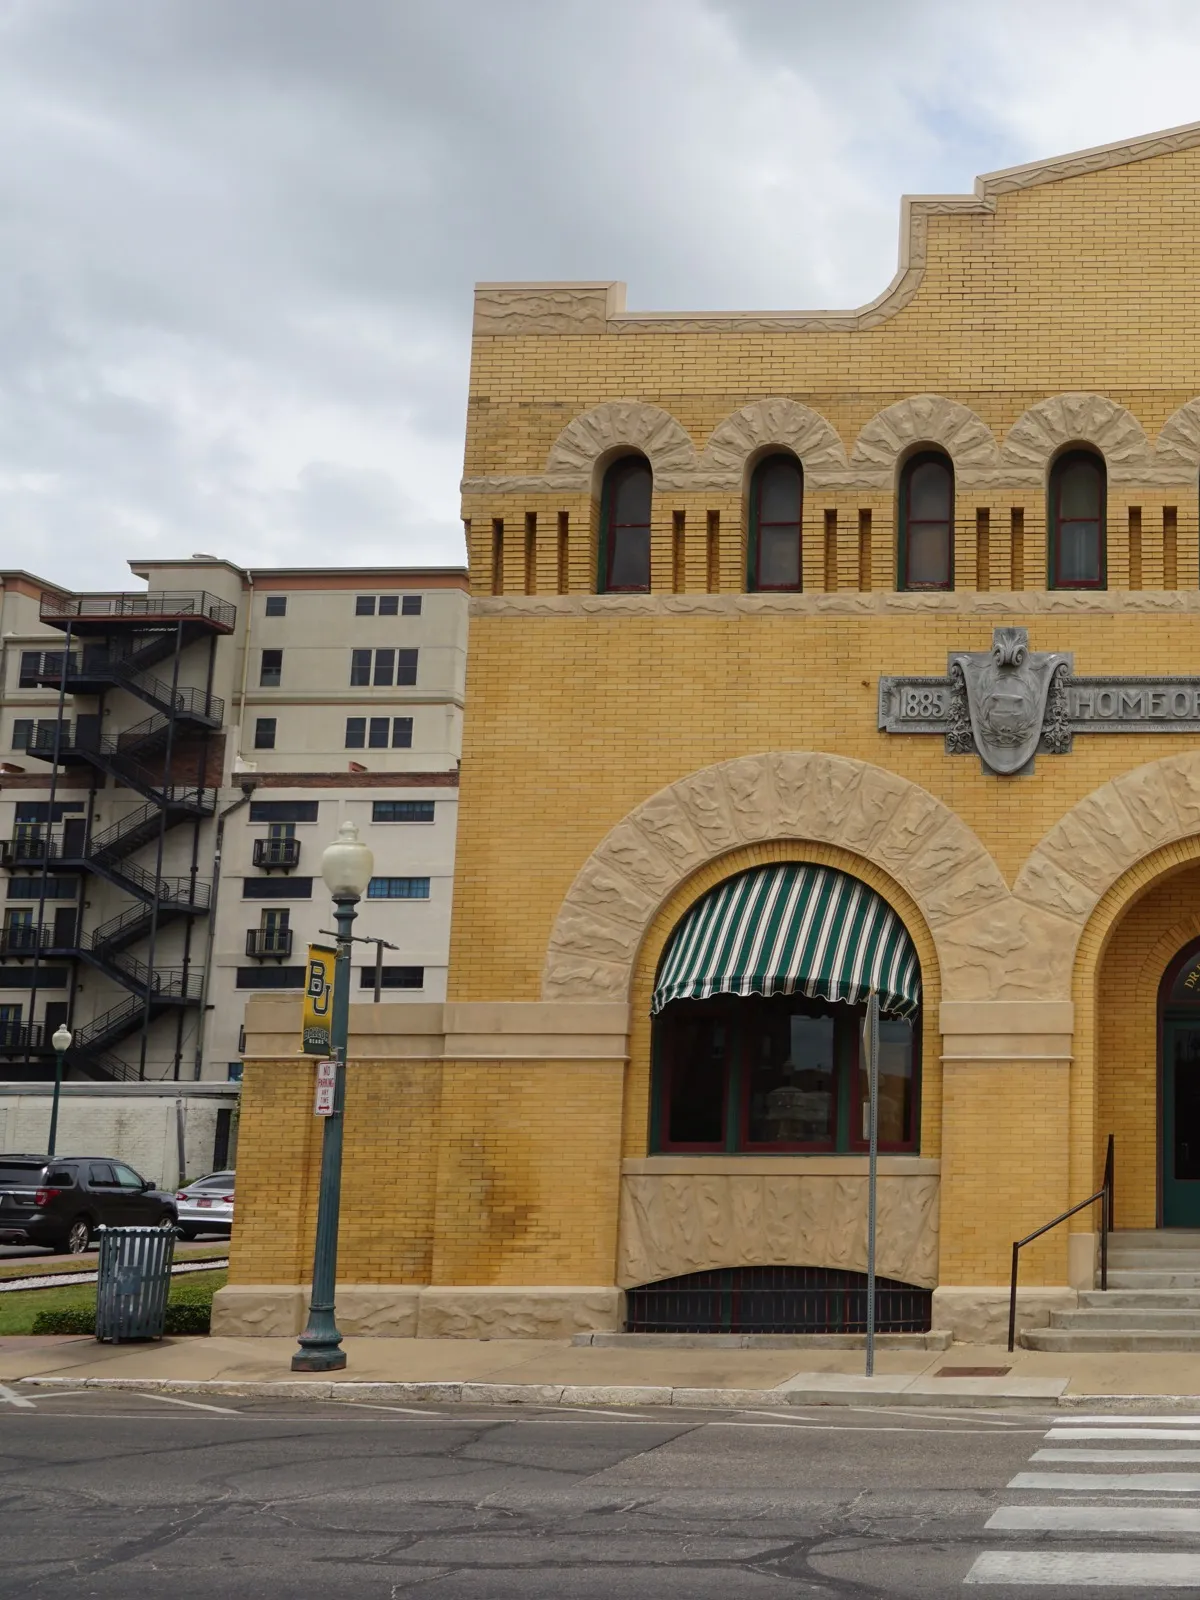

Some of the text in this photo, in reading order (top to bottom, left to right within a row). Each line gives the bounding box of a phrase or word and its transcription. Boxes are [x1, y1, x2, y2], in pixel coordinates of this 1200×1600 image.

[901, 691, 944, 718] 1885
[1075, 691, 1167, 718] HOME
[1184, 971, 1200, 989] DR
[323, 1065, 331, 1076] NO
[318, 1077, 334, 1088] PARKING
[319, 1096, 329, 1104] TIME
